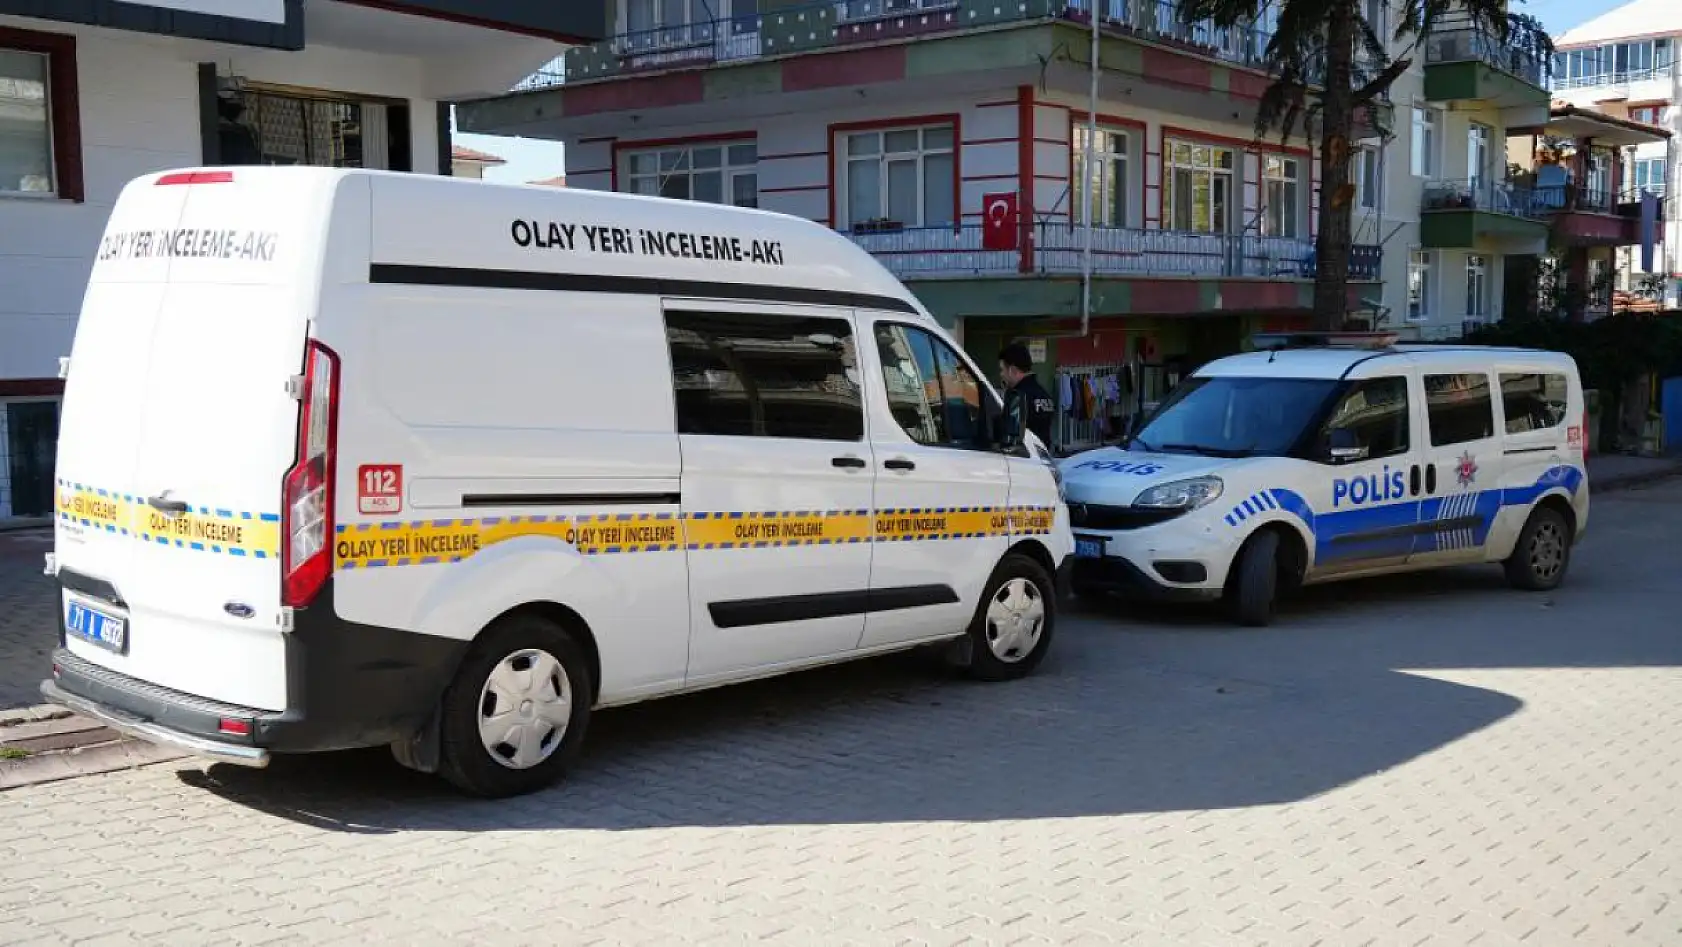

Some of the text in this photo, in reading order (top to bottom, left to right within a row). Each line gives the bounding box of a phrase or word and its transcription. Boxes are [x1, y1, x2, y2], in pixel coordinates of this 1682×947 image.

[511, 218, 576, 250] OLAY
[365, 470, 397, 493] 112
[1333, 464, 1404, 507] POLİS
[566, 527, 596, 544] OLAY
[735, 524, 759, 538] OLAY
[337, 540, 376, 558] OLAY
